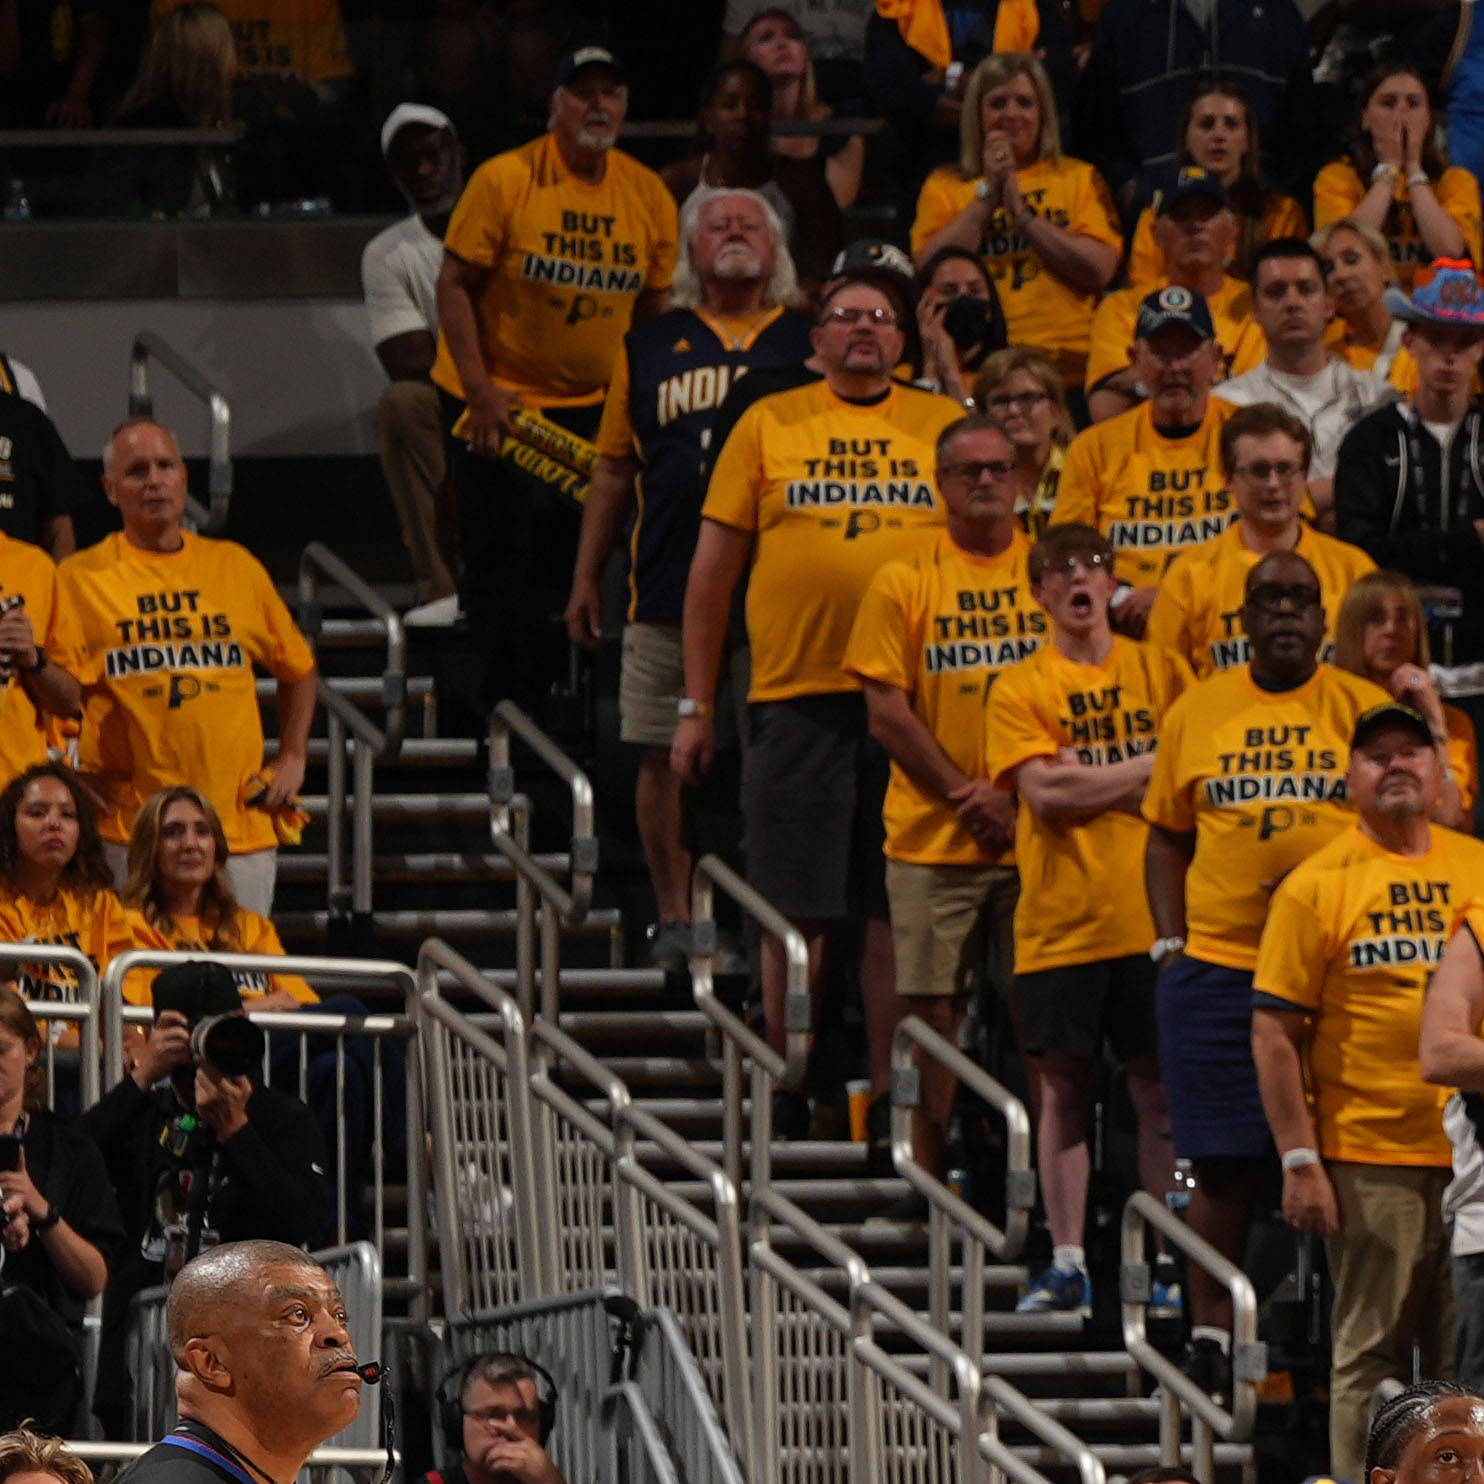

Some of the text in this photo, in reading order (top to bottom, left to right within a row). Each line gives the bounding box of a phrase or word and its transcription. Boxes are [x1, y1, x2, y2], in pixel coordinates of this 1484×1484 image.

[562, 211, 615, 239] BUT
[542, 234, 636, 264] THIS IS
[522, 254, 642, 294] INDIANA
[657, 365, 749, 427] INDI
[829, 437, 891, 458] BUT
[803, 458, 918, 480] THIS IS
[1149, 467, 1208, 492] BUT
[786, 479, 934, 511] INDIANA
[1125, 488, 1230, 518] THIS IS
[136, 592, 200, 615] BUT
[957, 588, 1019, 611] BUT
[115, 614, 231, 639] THIS IS
[935, 610, 1045, 639] THIS IS
[104, 642, 242, 677] INDIANA
[926, 640, 1039, 675] INDIAN
[1068, 687, 1122, 716] BUT
[1125, 710, 1154, 734] IS
[1244, 726, 1311, 748] BUT
[1219, 750, 1337, 774] THIS IS
[1204, 777, 1349, 807] INDIANA
[1389, 881, 1451, 905] BUT
[1365, 911, 1445, 935] THIS
[1349, 935, 1446, 969] INDIA
